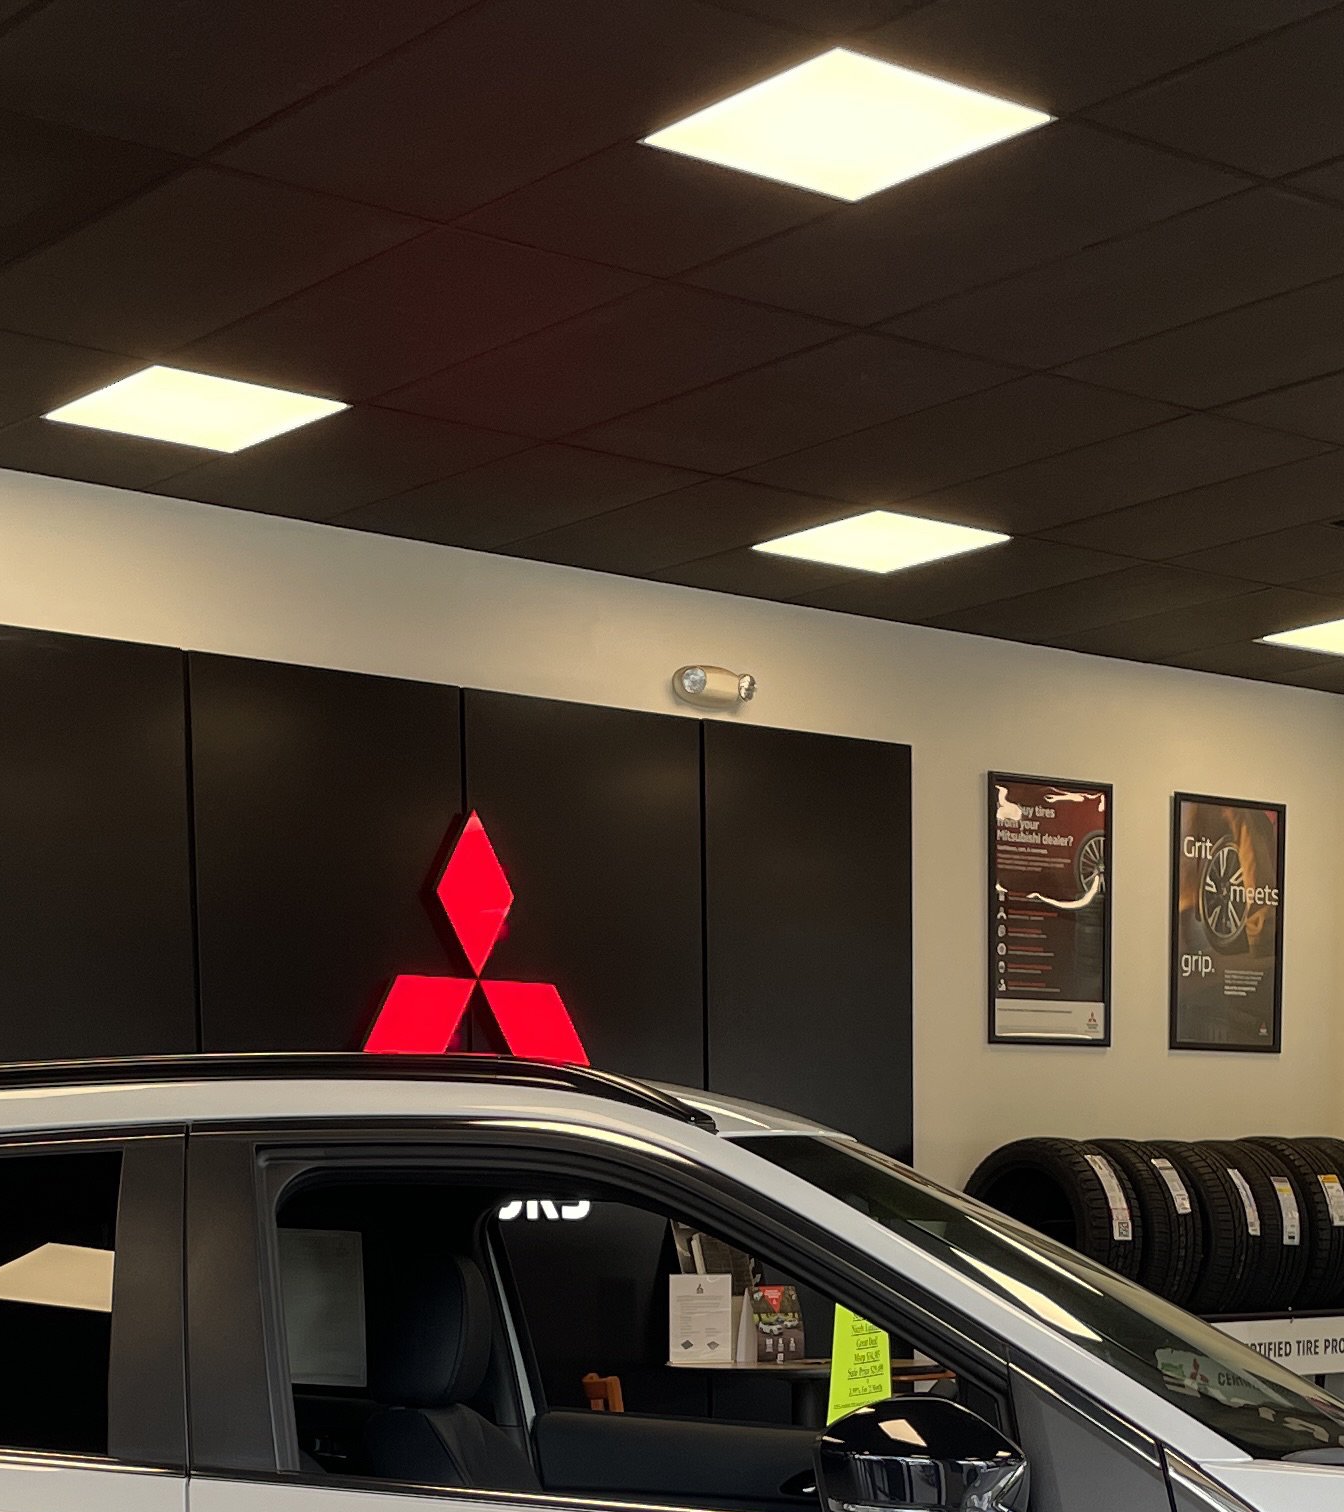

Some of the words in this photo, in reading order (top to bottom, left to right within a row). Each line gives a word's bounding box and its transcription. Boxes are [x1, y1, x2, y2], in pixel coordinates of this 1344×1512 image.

[1020, 820, 1040, 830] your
[997, 829, 1041, 845] Mitsubishi
[1042, 833, 1074, 847] dealer?
[1183, 836, 1213, 860] Grit
[1229, 884, 1279, 906] meets
[1181, 950, 1215, 978] grip.
[1296, 1339, 1320, 1356] TIRE
